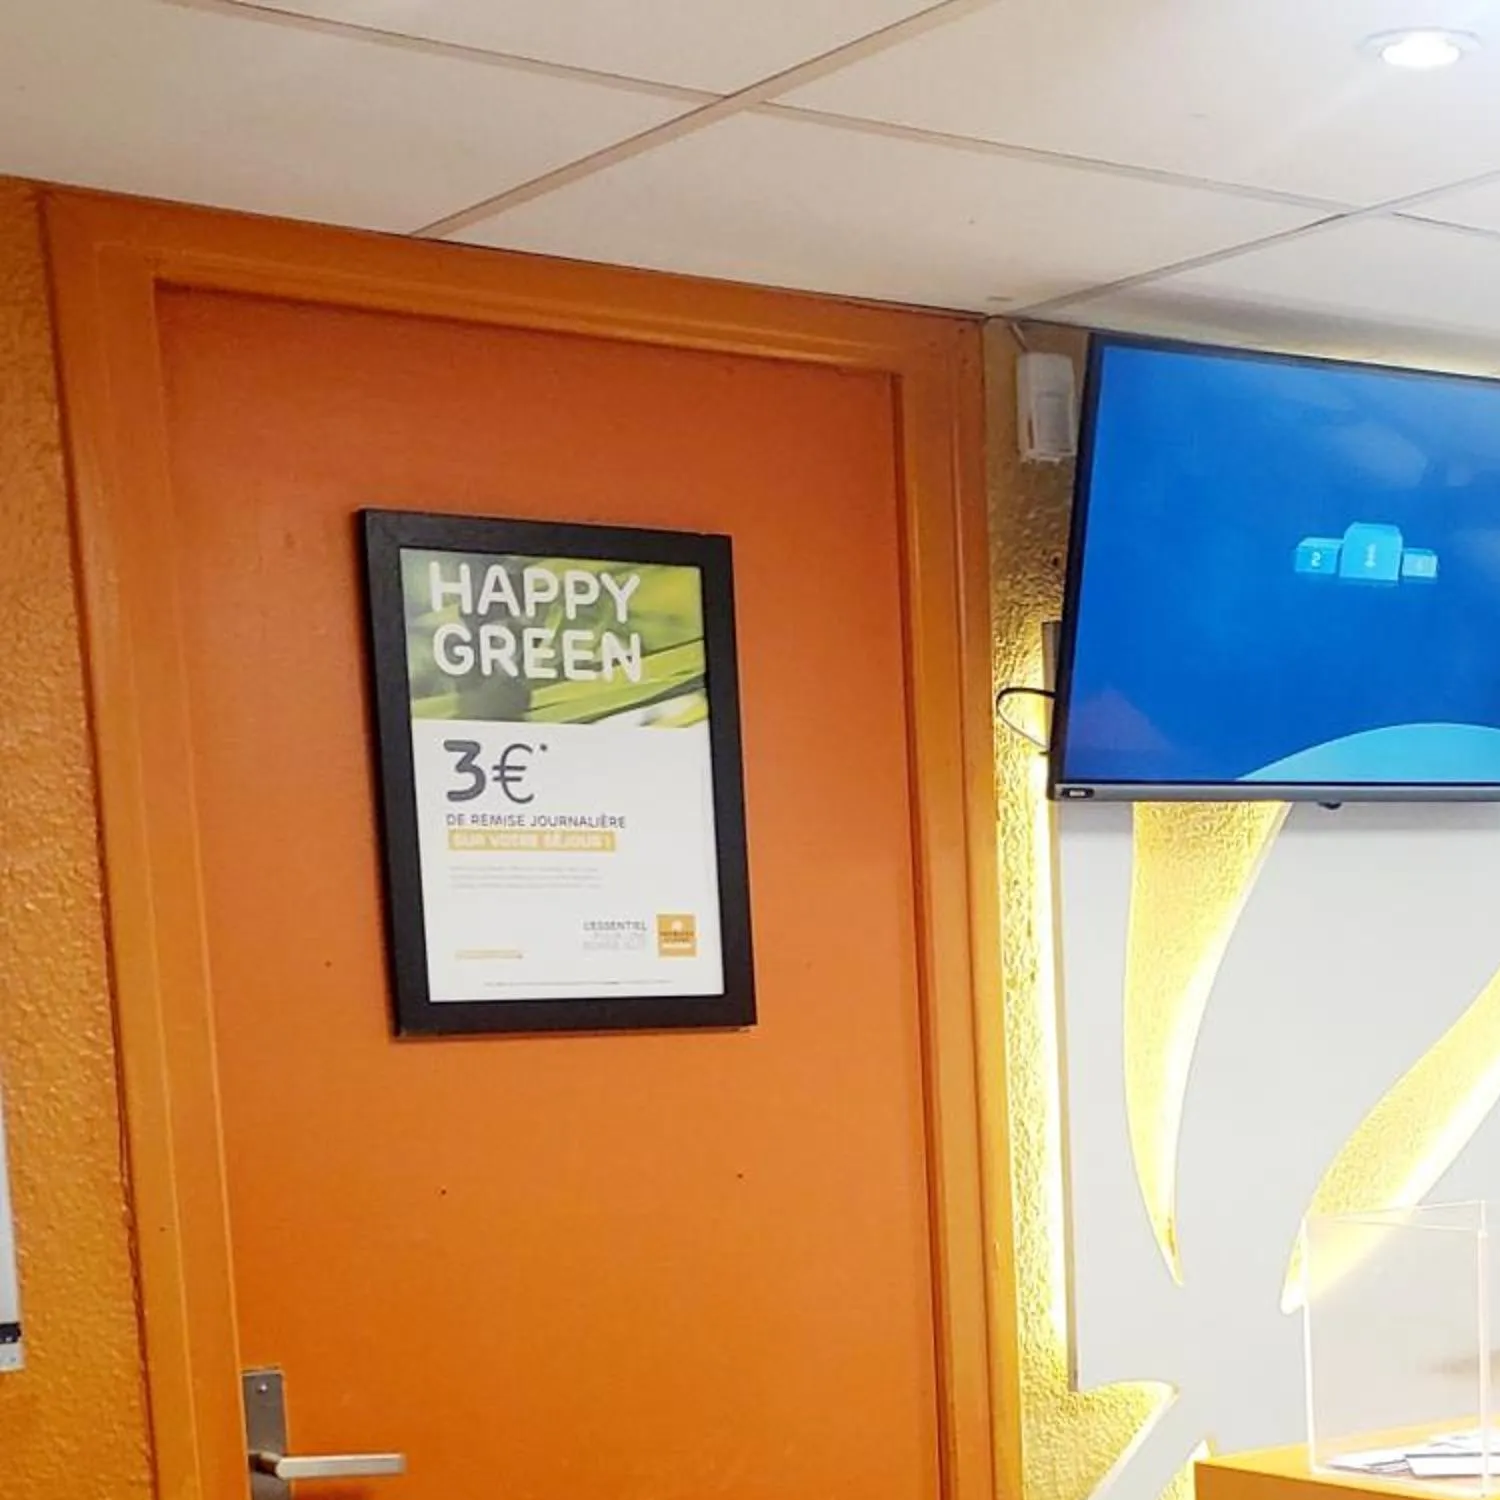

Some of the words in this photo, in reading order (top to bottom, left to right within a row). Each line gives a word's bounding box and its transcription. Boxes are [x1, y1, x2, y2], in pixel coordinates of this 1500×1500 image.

[429, 561, 641, 623] HAPPY
[433, 623, 641, 683] GREEN
[446, 813, 466, 827] DE
[470, 813, 526, 828] REMISE
[529, 814, 627, 829] JOURNALIÈRE
